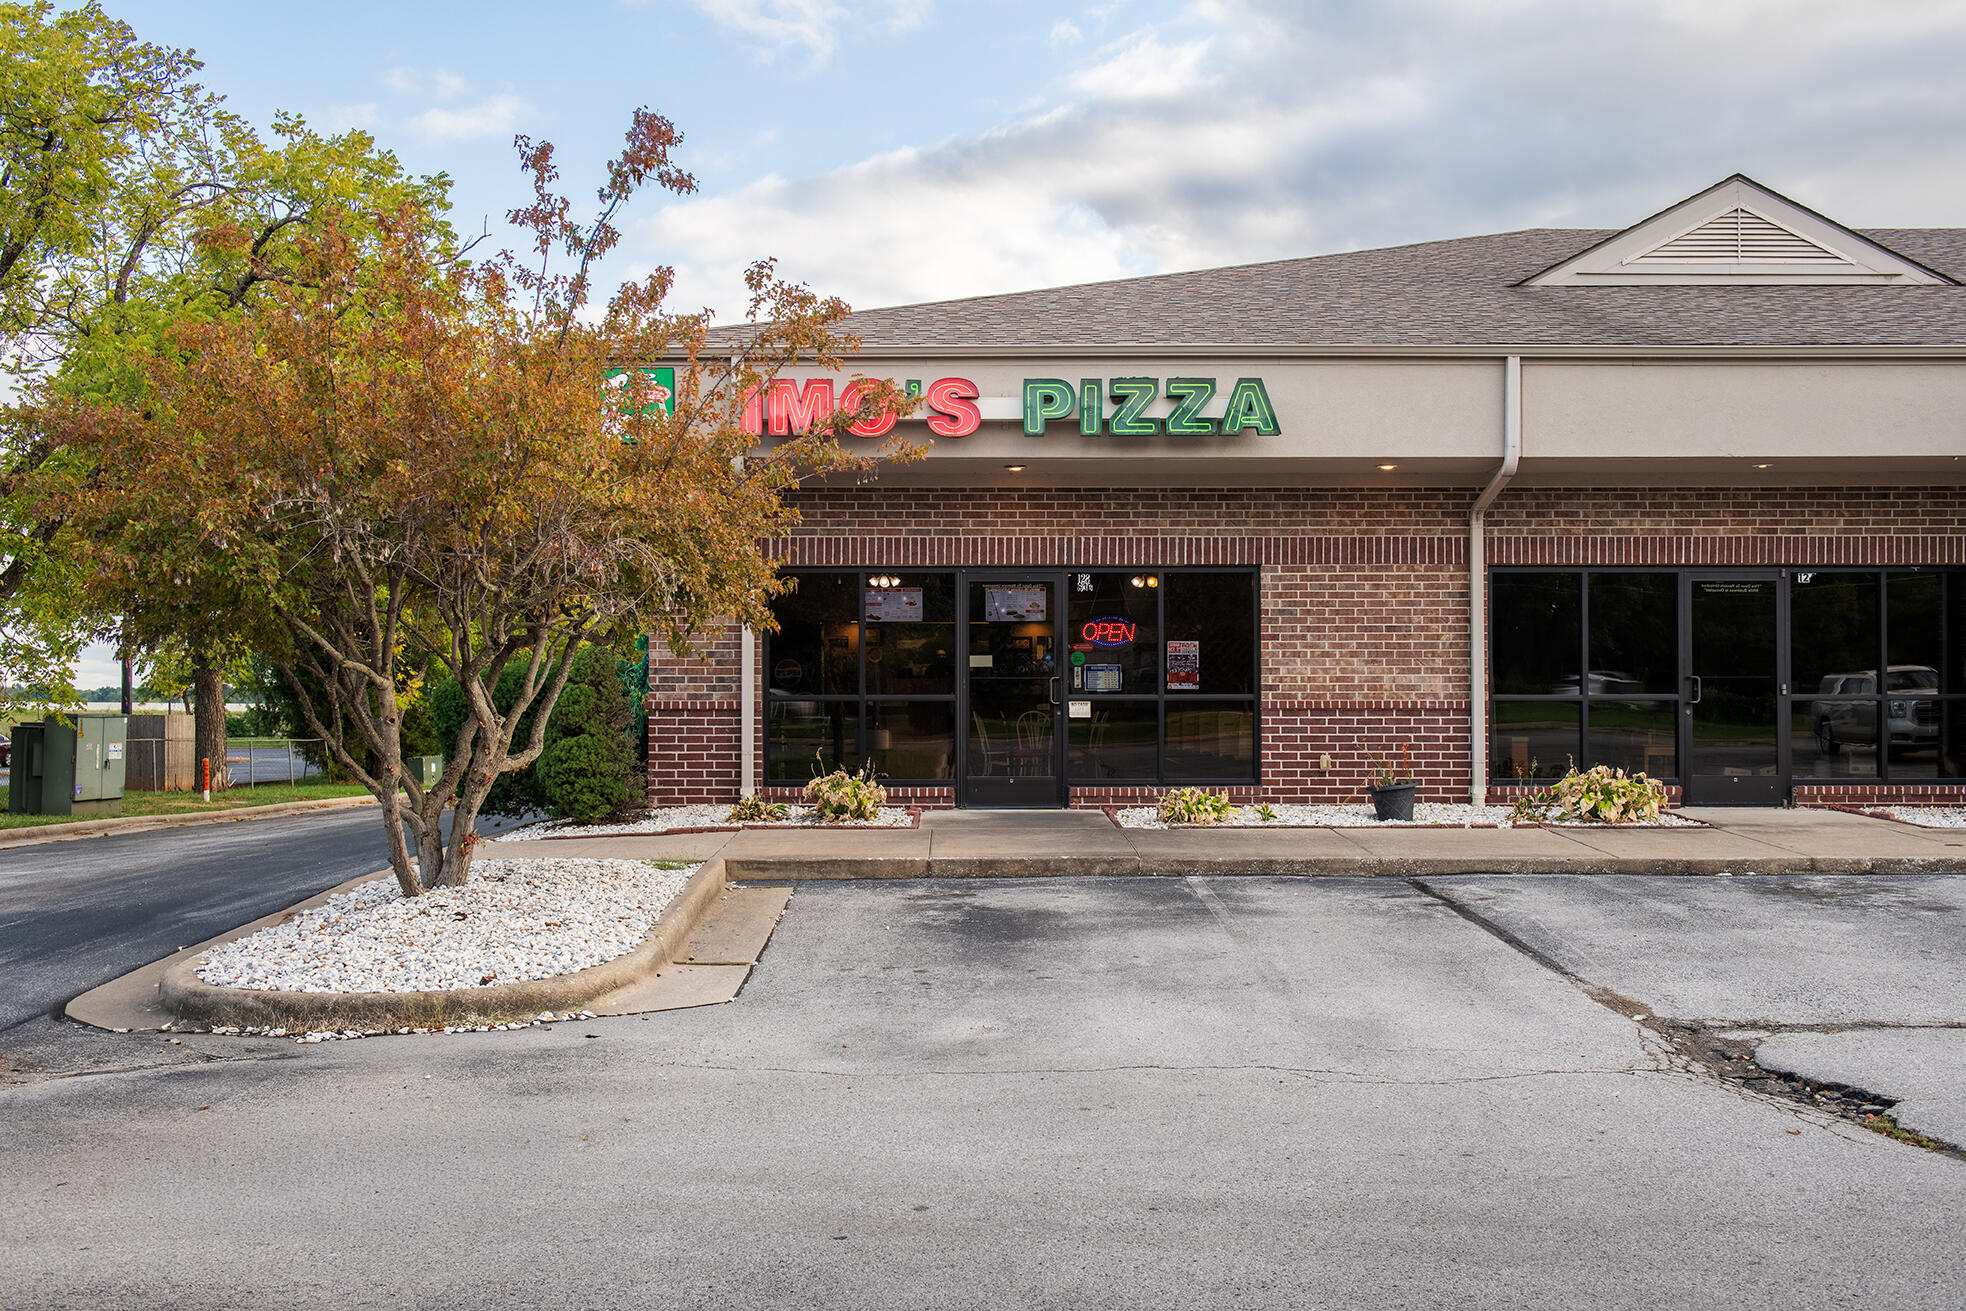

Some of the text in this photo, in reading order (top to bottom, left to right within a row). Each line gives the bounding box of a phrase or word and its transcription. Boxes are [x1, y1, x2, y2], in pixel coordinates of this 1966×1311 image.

[740, 377, 1282, 438] IMO'S PIZZA
[1082, 622, 1136, 642] OPEN
